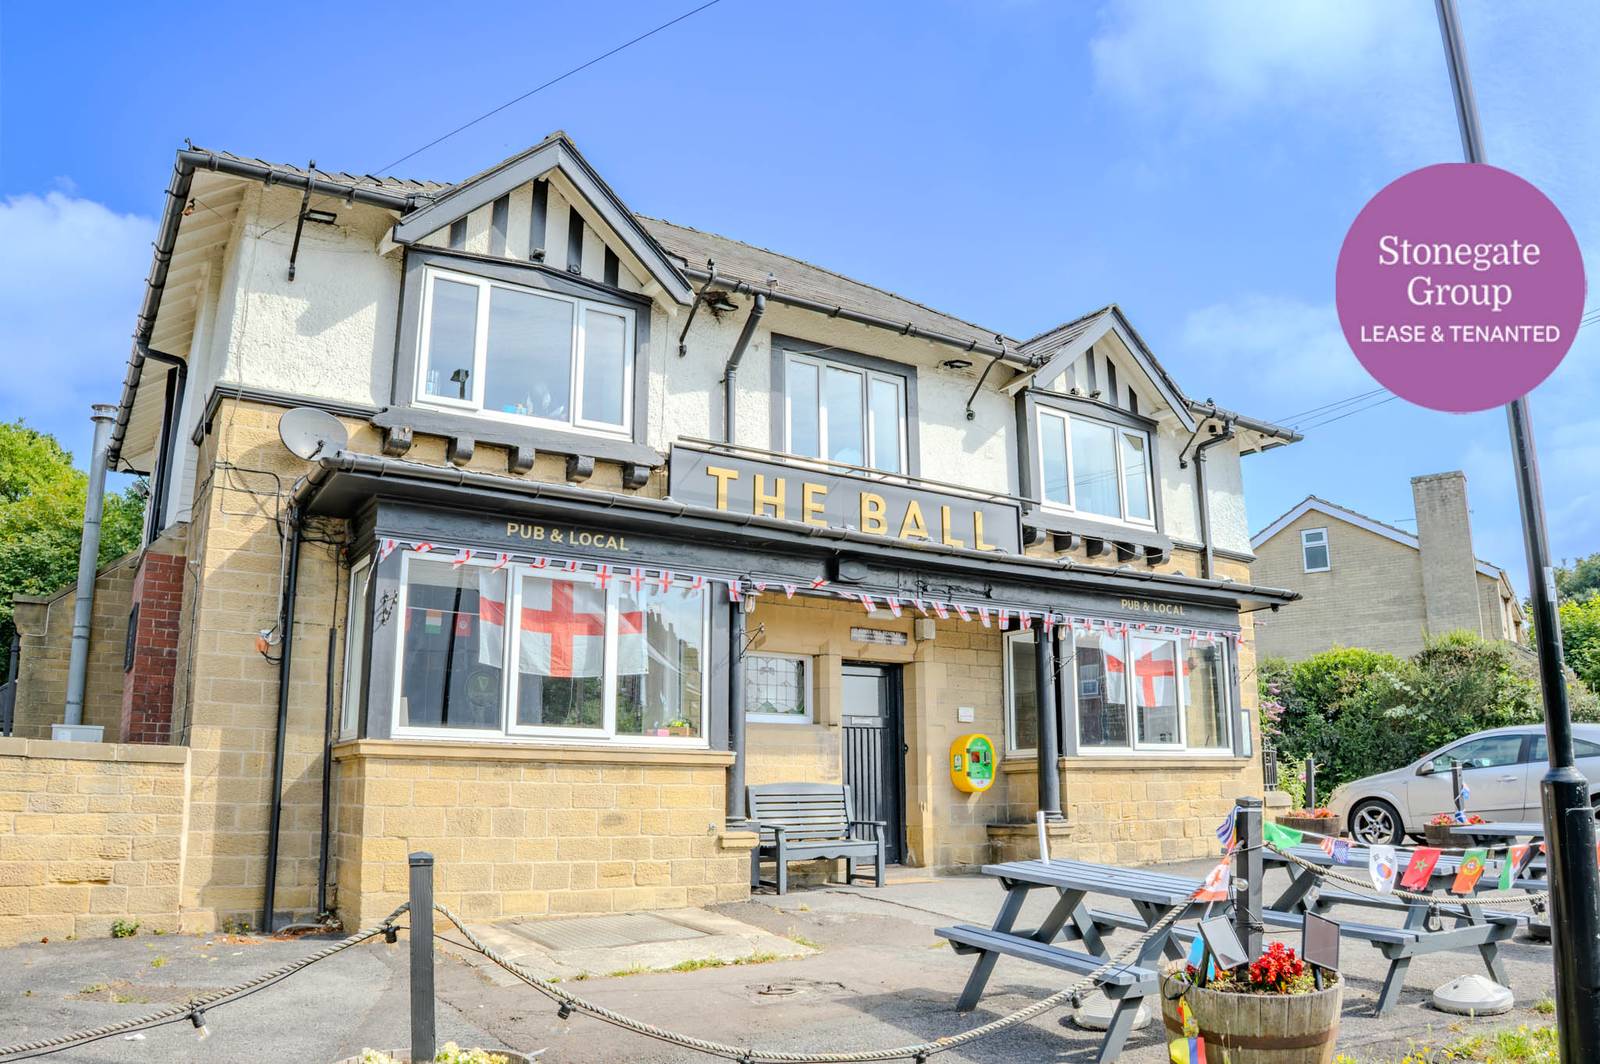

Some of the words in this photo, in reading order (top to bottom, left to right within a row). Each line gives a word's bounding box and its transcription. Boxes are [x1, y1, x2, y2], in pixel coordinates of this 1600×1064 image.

[706, 466, 828, 528] THE
[859, 491, 998, 551] BALL
[506, 522, 545, 541] PUB
[550, 528, 564, 544] &
[569, 531, 630, 551] LOCAL
[1121, 599, 1140, 611] PUB
[1142, 602, 1150, 612] &
[1153, 603, 1185, 616] LOCAL
